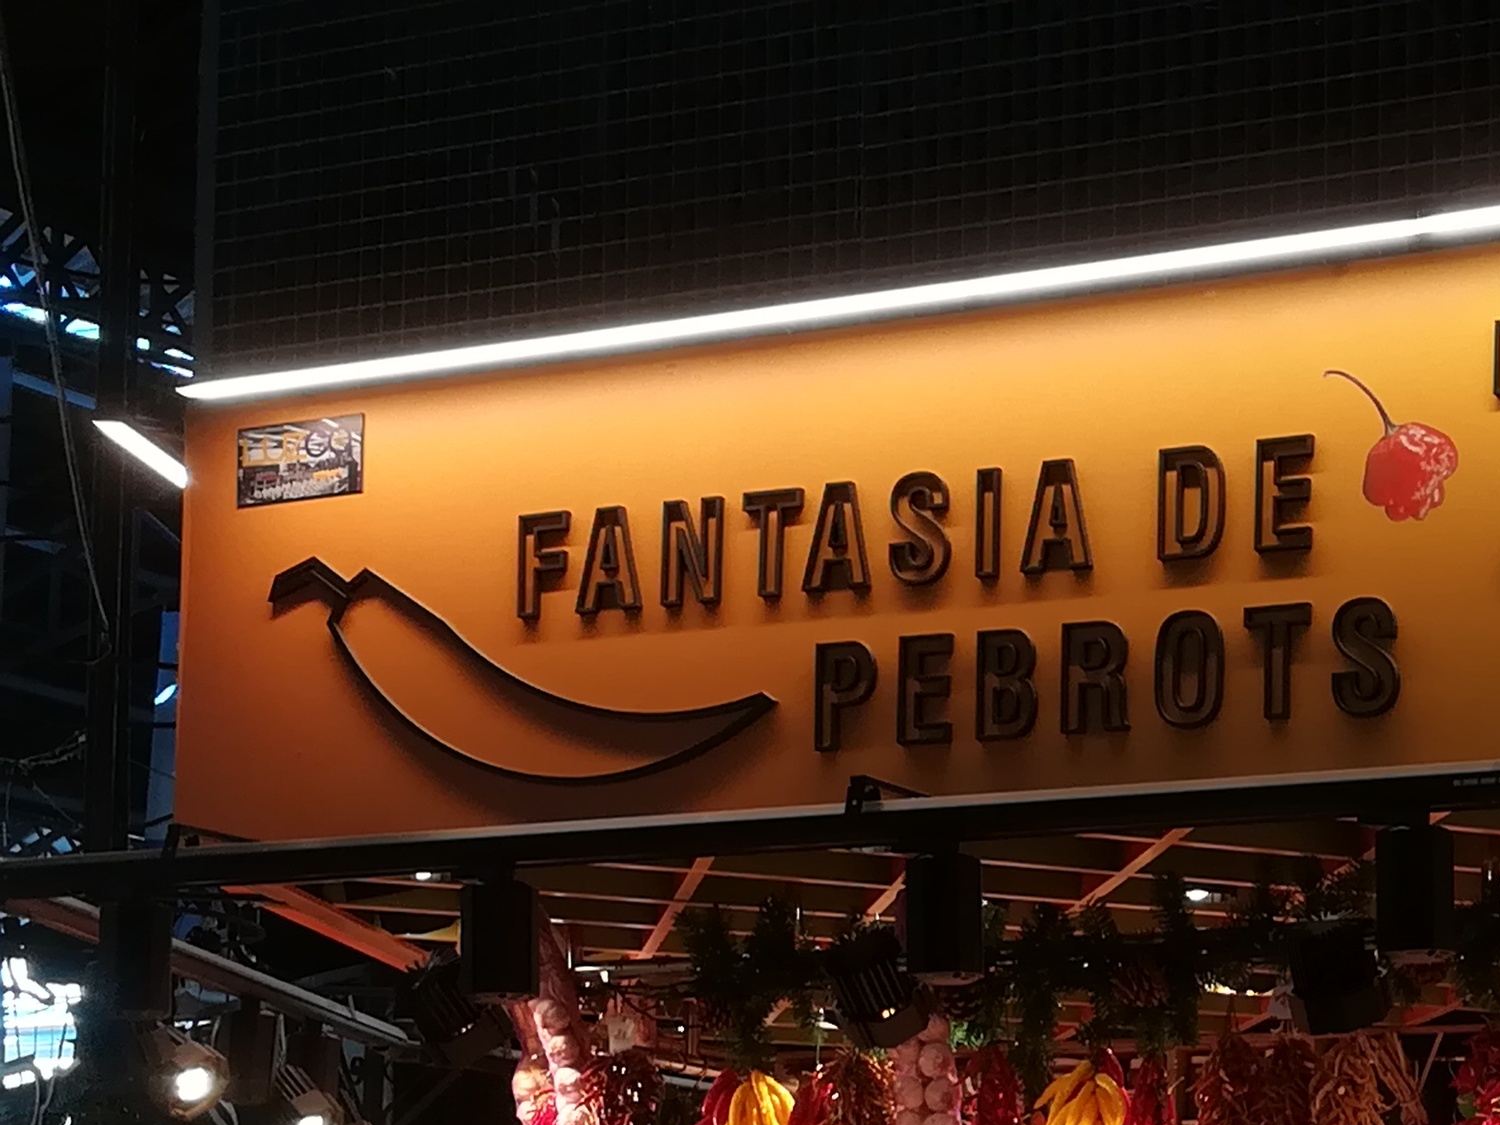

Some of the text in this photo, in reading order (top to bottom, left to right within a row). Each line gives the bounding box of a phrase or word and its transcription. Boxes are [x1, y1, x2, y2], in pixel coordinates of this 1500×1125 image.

[516, 434, 1315, 620] FANTASIA DE
[814, 596, 1401, 752] PEBROTS
